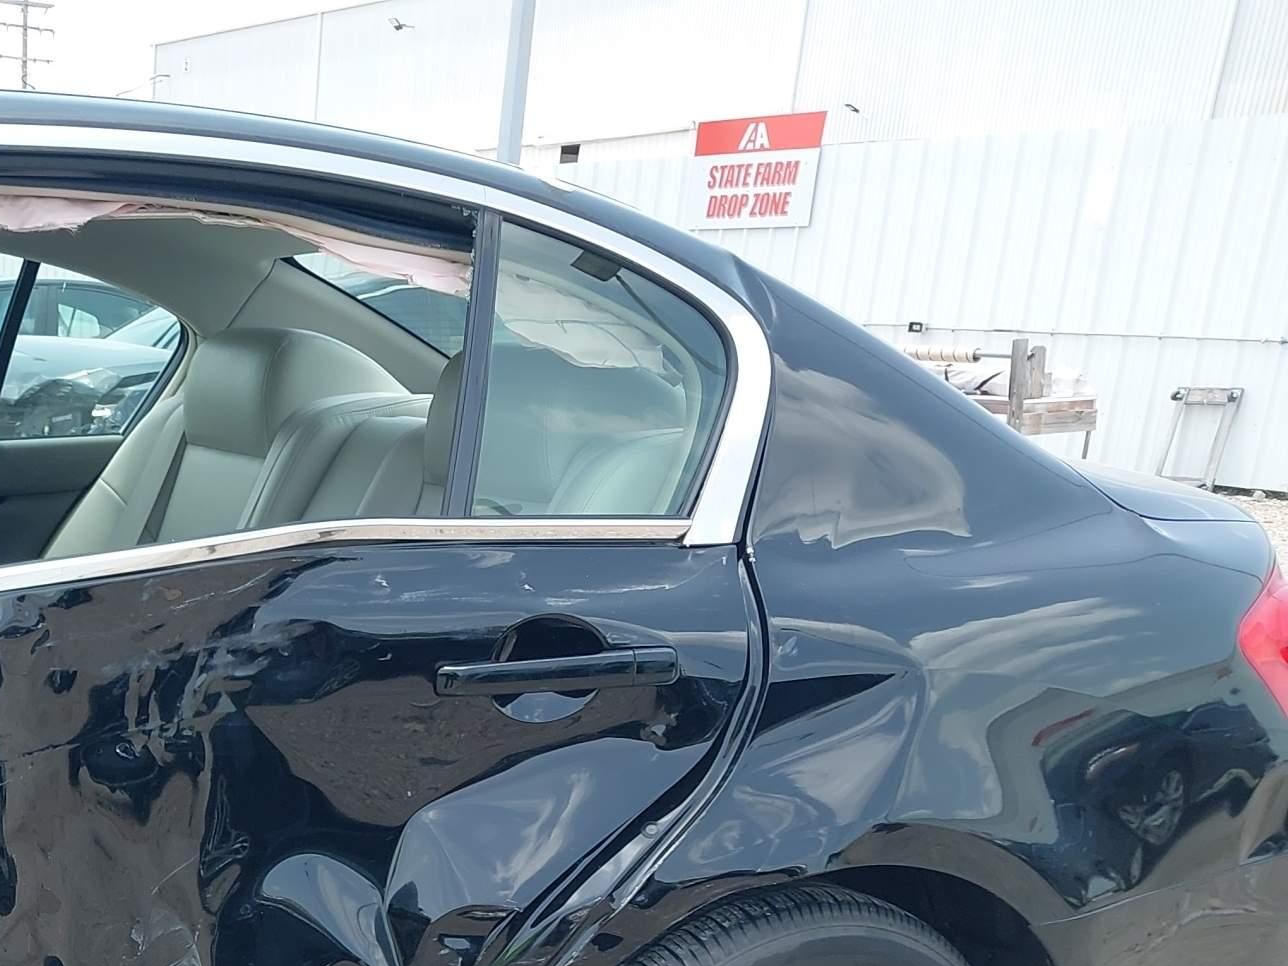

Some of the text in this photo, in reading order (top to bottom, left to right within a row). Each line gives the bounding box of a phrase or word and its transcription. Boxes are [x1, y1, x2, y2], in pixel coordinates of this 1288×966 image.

[707, 160, 800, 189] STATE FARM
[706, 191, 792, 218] DROP ZONE
